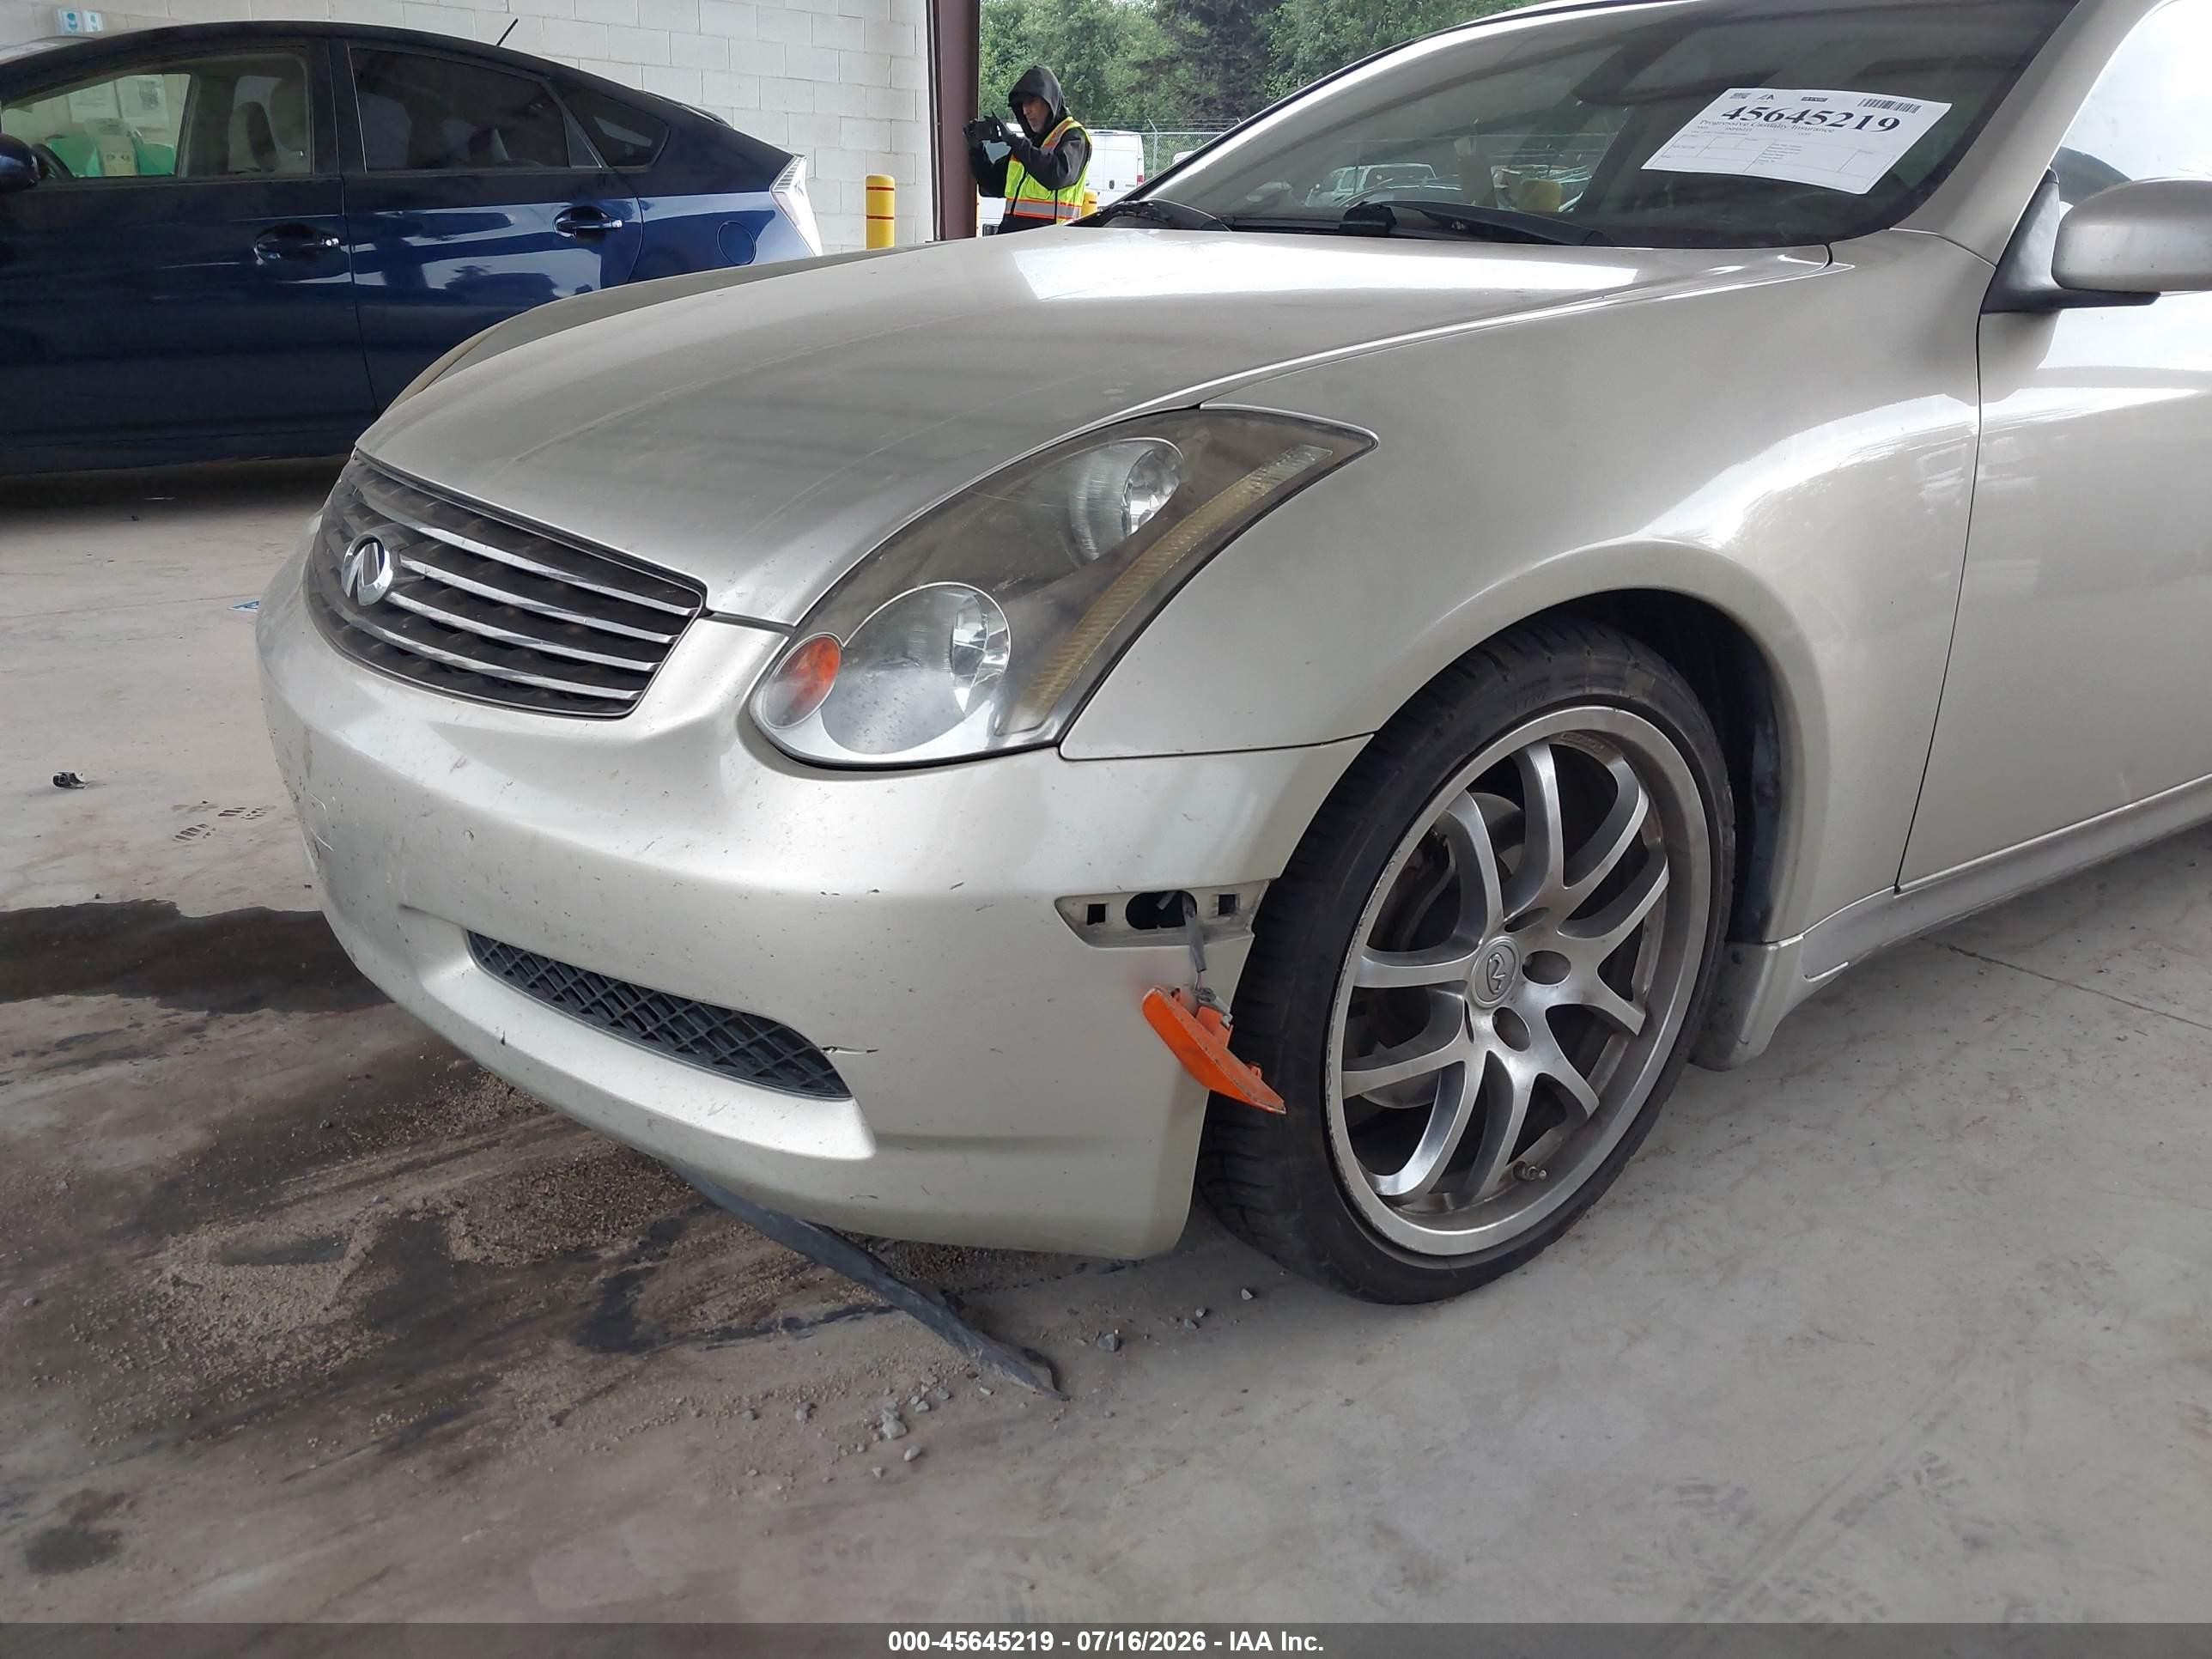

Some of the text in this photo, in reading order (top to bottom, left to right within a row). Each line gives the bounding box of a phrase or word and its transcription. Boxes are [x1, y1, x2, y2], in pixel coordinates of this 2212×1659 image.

[1698, 118, 1749, 127] Progressive
[1791, 125, 1835, 133] Insurance
[1721, 105, 1901, 133] 45645219
